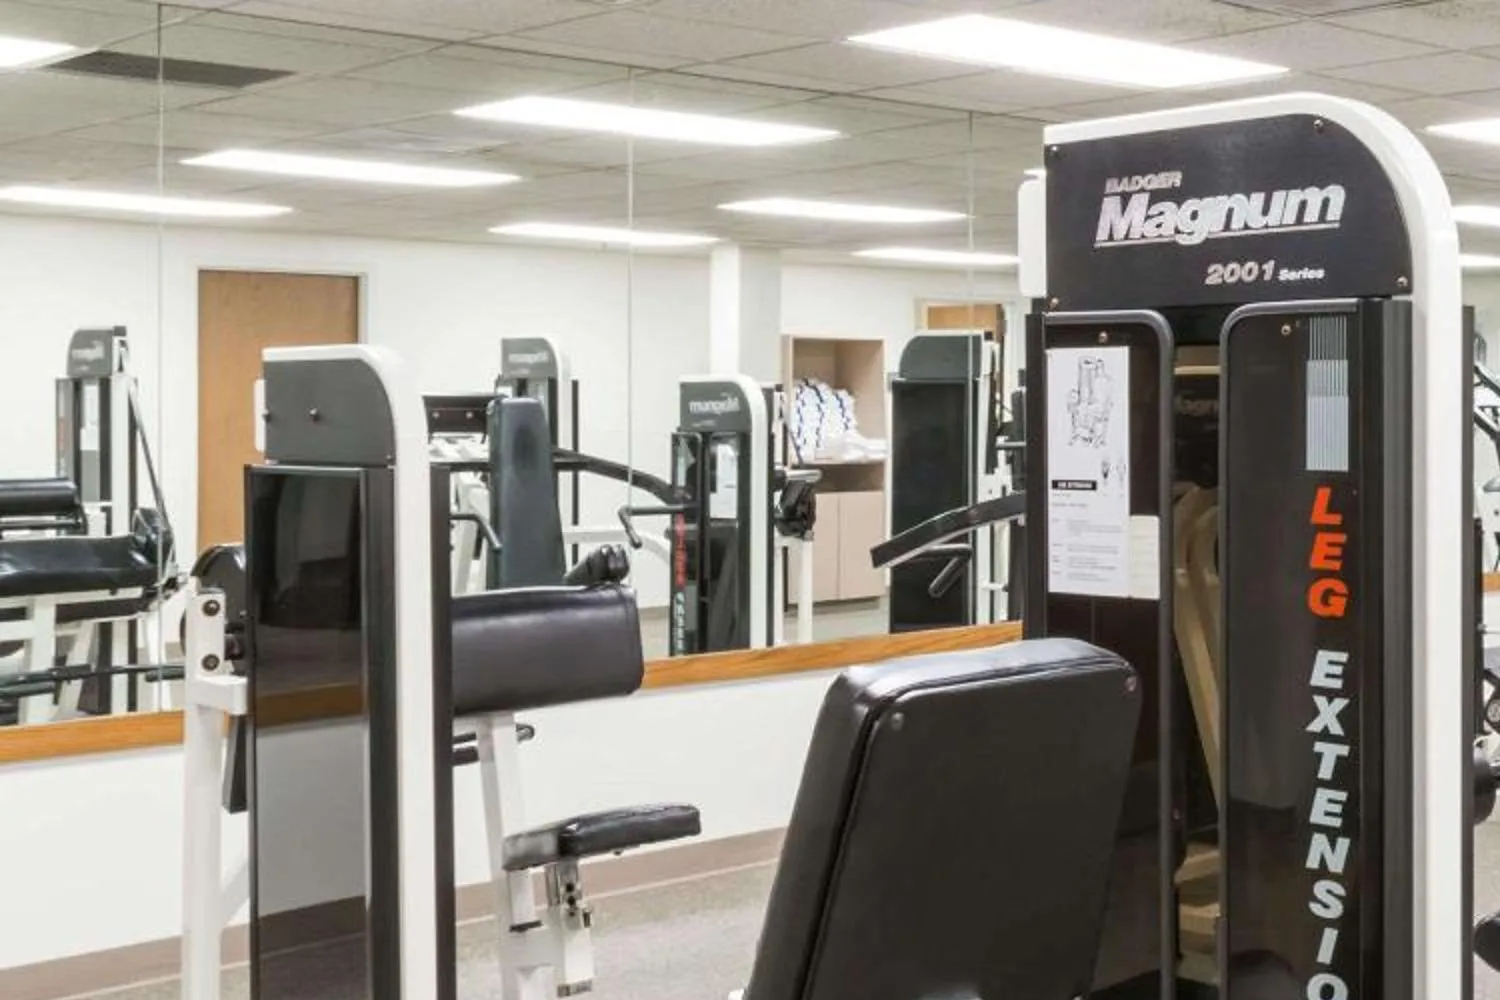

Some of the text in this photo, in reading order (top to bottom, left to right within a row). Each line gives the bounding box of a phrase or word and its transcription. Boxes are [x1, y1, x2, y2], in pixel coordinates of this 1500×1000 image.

[1095, 184, 1346, 246] Magnum
[1205, 259, 1325, 286] 2001 Series
[1307, 486, 1348, 619] LEG
